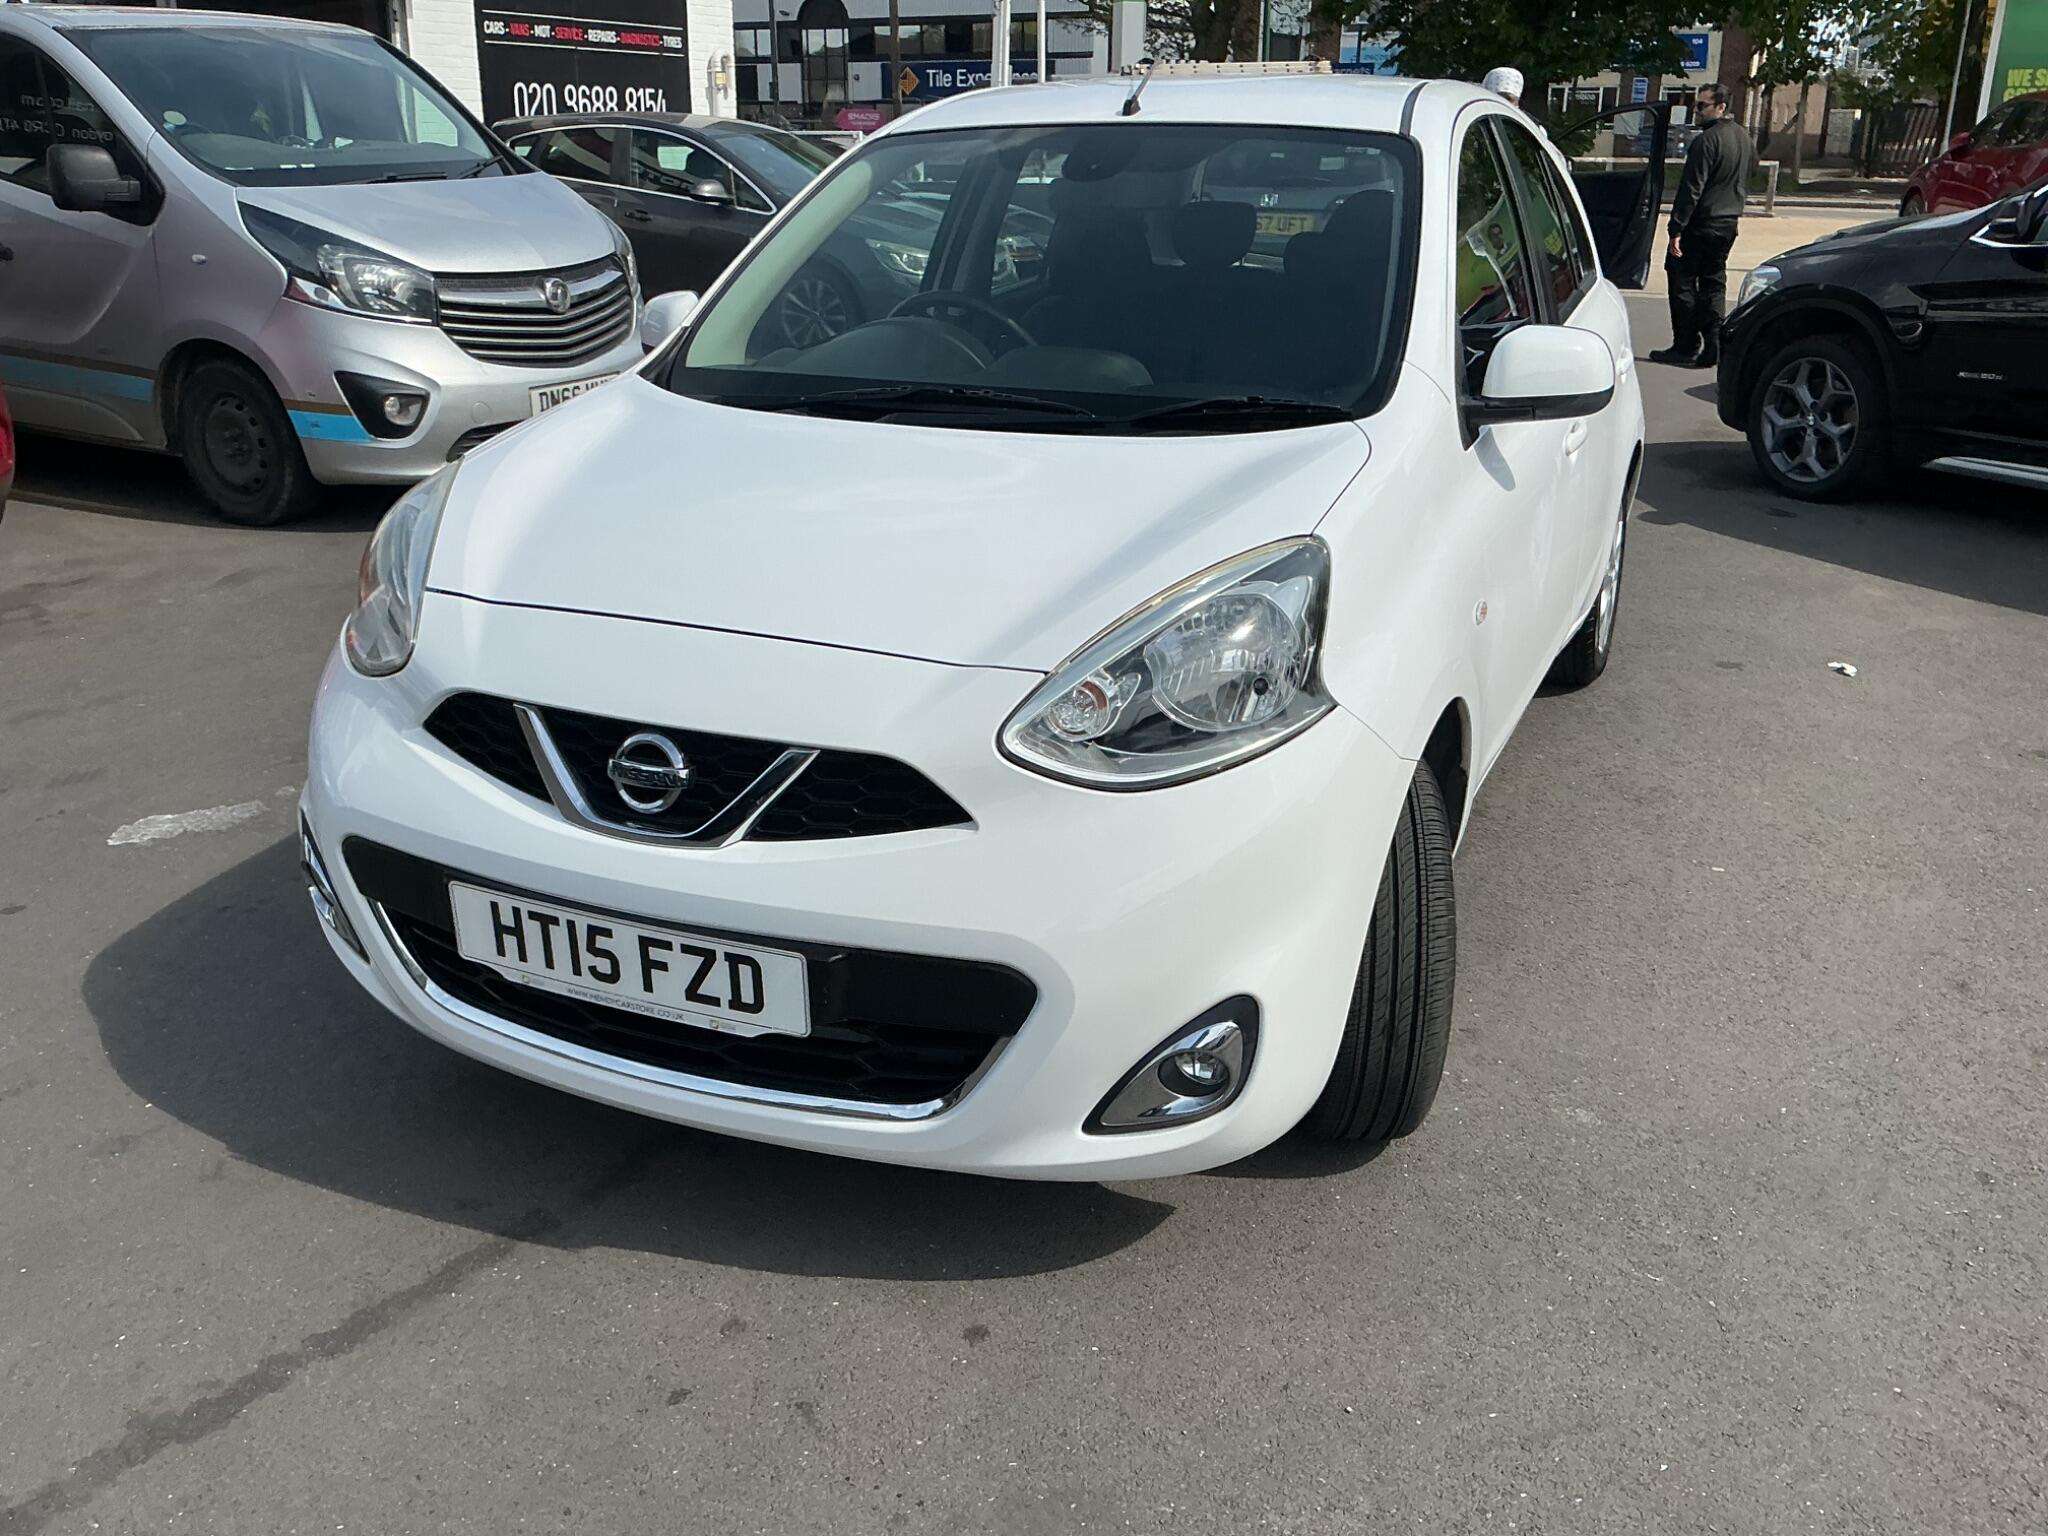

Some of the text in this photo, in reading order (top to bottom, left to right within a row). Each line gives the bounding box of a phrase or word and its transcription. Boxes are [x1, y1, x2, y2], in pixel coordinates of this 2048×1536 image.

[484, 20, 683, 48] CARS VANS MOT SERVICE REPAIRS DIAGNOSTICS TYRES
[926, 69, 952, 87] Tile
[514, 82, 666, 117] 020 8688 8154
[490, 900, 765, 1015] HT15 FZD
